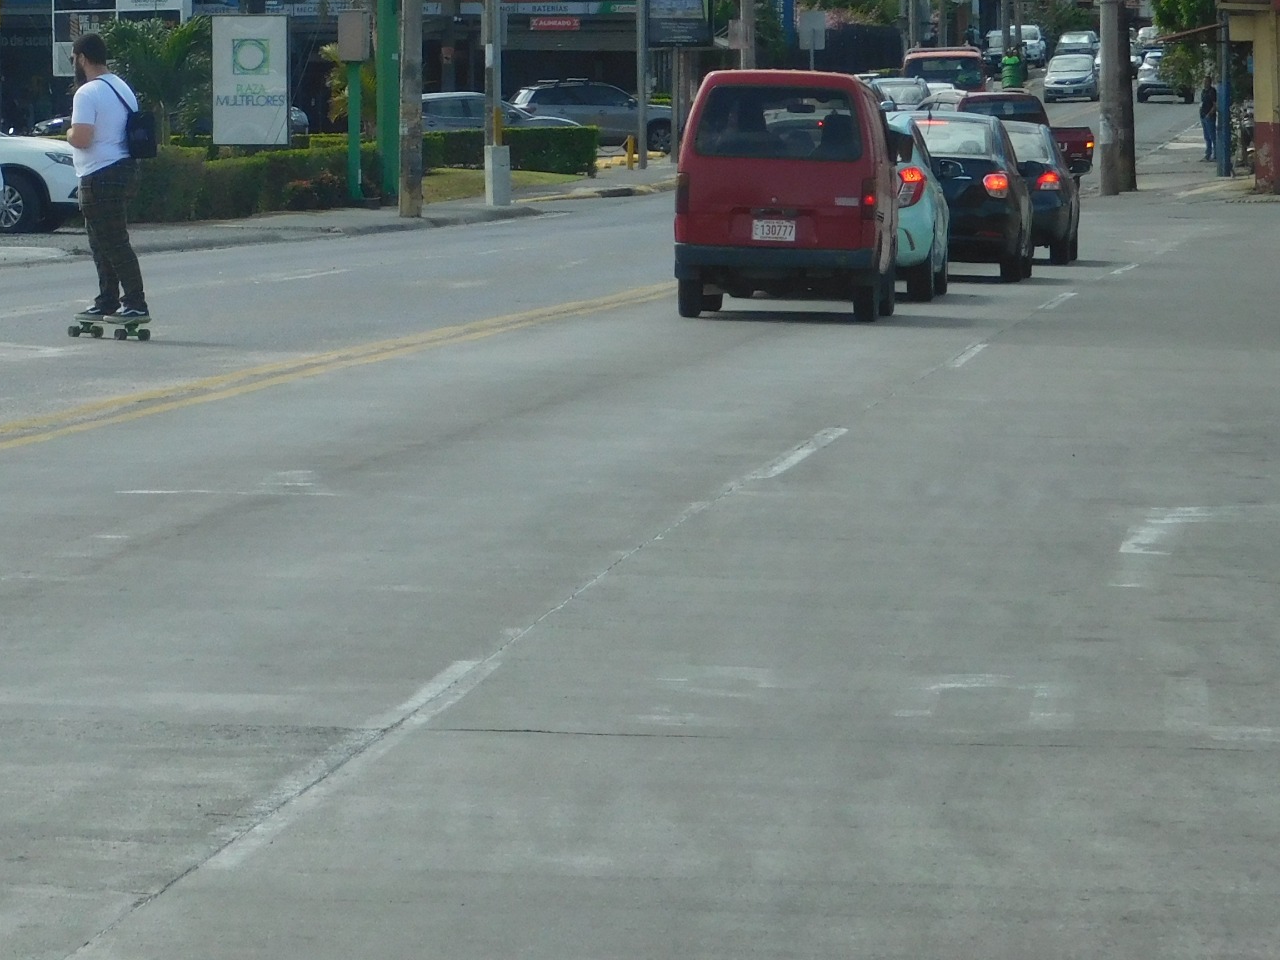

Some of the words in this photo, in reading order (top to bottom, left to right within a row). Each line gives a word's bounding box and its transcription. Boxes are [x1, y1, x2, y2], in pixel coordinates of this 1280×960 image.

[236, 84, 266, 94] PLAZA
[216, 94, 286, 107] MULTIFLORES
[760, 224, 794, 236] 130777
